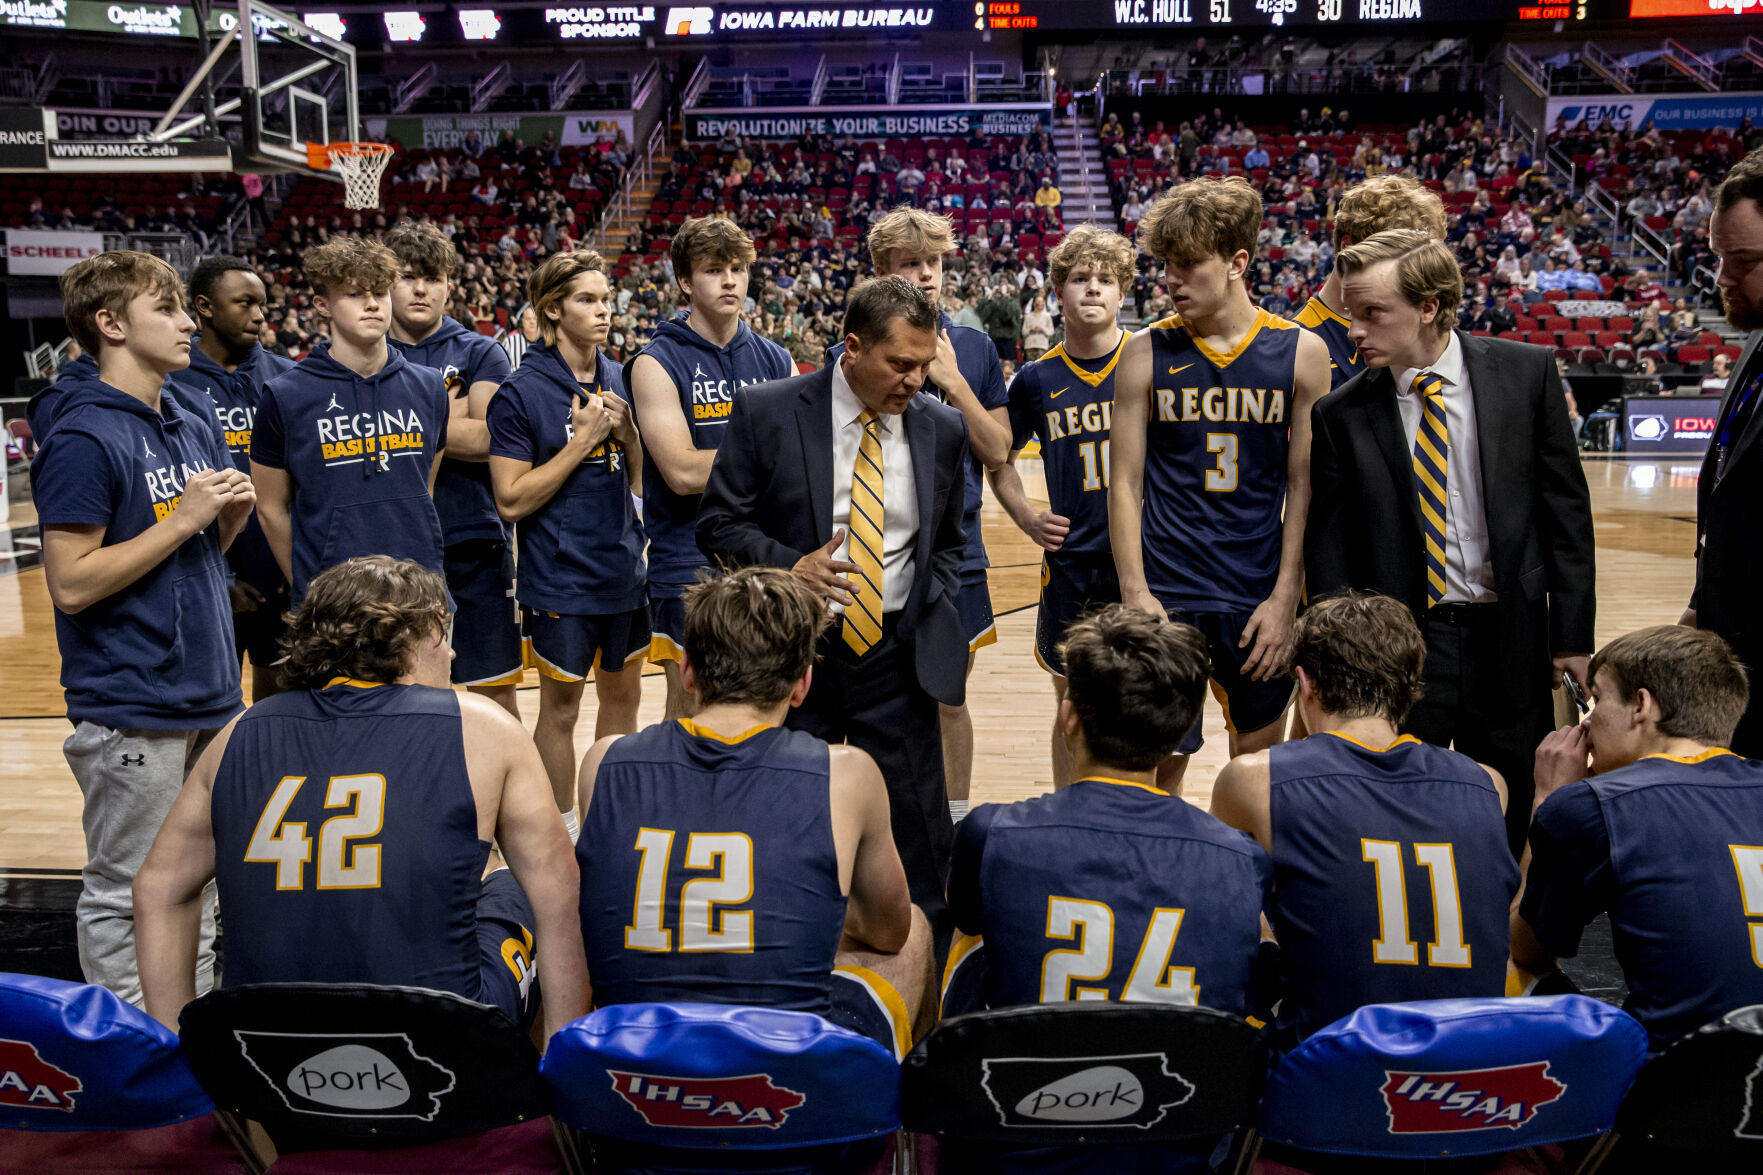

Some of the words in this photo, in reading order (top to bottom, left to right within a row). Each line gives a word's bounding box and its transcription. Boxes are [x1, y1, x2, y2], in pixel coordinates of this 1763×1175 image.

[545, 8, 604, 22] PROUD
[607, 7, 655, 21] TITLE
[989, 3, 1020, 14] FOULS
[1210, 0, 1232, 22] 51
[1317, 0, 1342, 20] 30
[1359, 0, 1422, 19] REGINA
[1519, 7, 1541, 19] TIME
[1543, 7, 1570, 18] OUTS
[1576, 6, 1586, 20] 3
[720, 13, 774, 29] IOWA
[778, 11, 839, 28] FARM
[843, 9, 933, 27] BUREAU
[989, 17, 1011, 28] TIME
[1012, 16, 1037, 28] OUTS
[560, 23, 640, 38] SPONSOR
[983, 113, 1039, 123] MEDIACOM
[1585, 105, 1633, 120] EMC
[1654, 110, 1681, 120] OUR
[1683, 108, 1743, 119] BUSINESS
[57, 115, 97, 131] OIN
[456, 118, 490, 130] THINGS
[493, 117, 520, 130] RIGHT
[578, 120, 619, 133] WM
[697, 118, 826, 137] REVOLUTIONIZE
[832, 118, 879, 134] YOUR
[885, 117, 970, 133] BUSINESS
[52, 144, 179, 157] WWW.DMACC.edu
[1156, 386, 1285, 424] REGINA
[317, 408, 424, 444] REGINA
[1046, 400, 1114, 441] REGI
[1674, 417, 1717, 431] IOW
[1205, 432, 1239, 493] 3
[243, 773, 387, 891] 42
[624, 827, 755, 953] 12
[1360, 838, 1472, 968] 11
[1039, 895, 1201, 1005] 24
[298, 1063, 404, 1096] pork
[628, 1076, 774, 1123] IHSAA
[1031, 1082, 1137, 1115] pork
[1395, 1075, 1524, 1125] IHSAA
